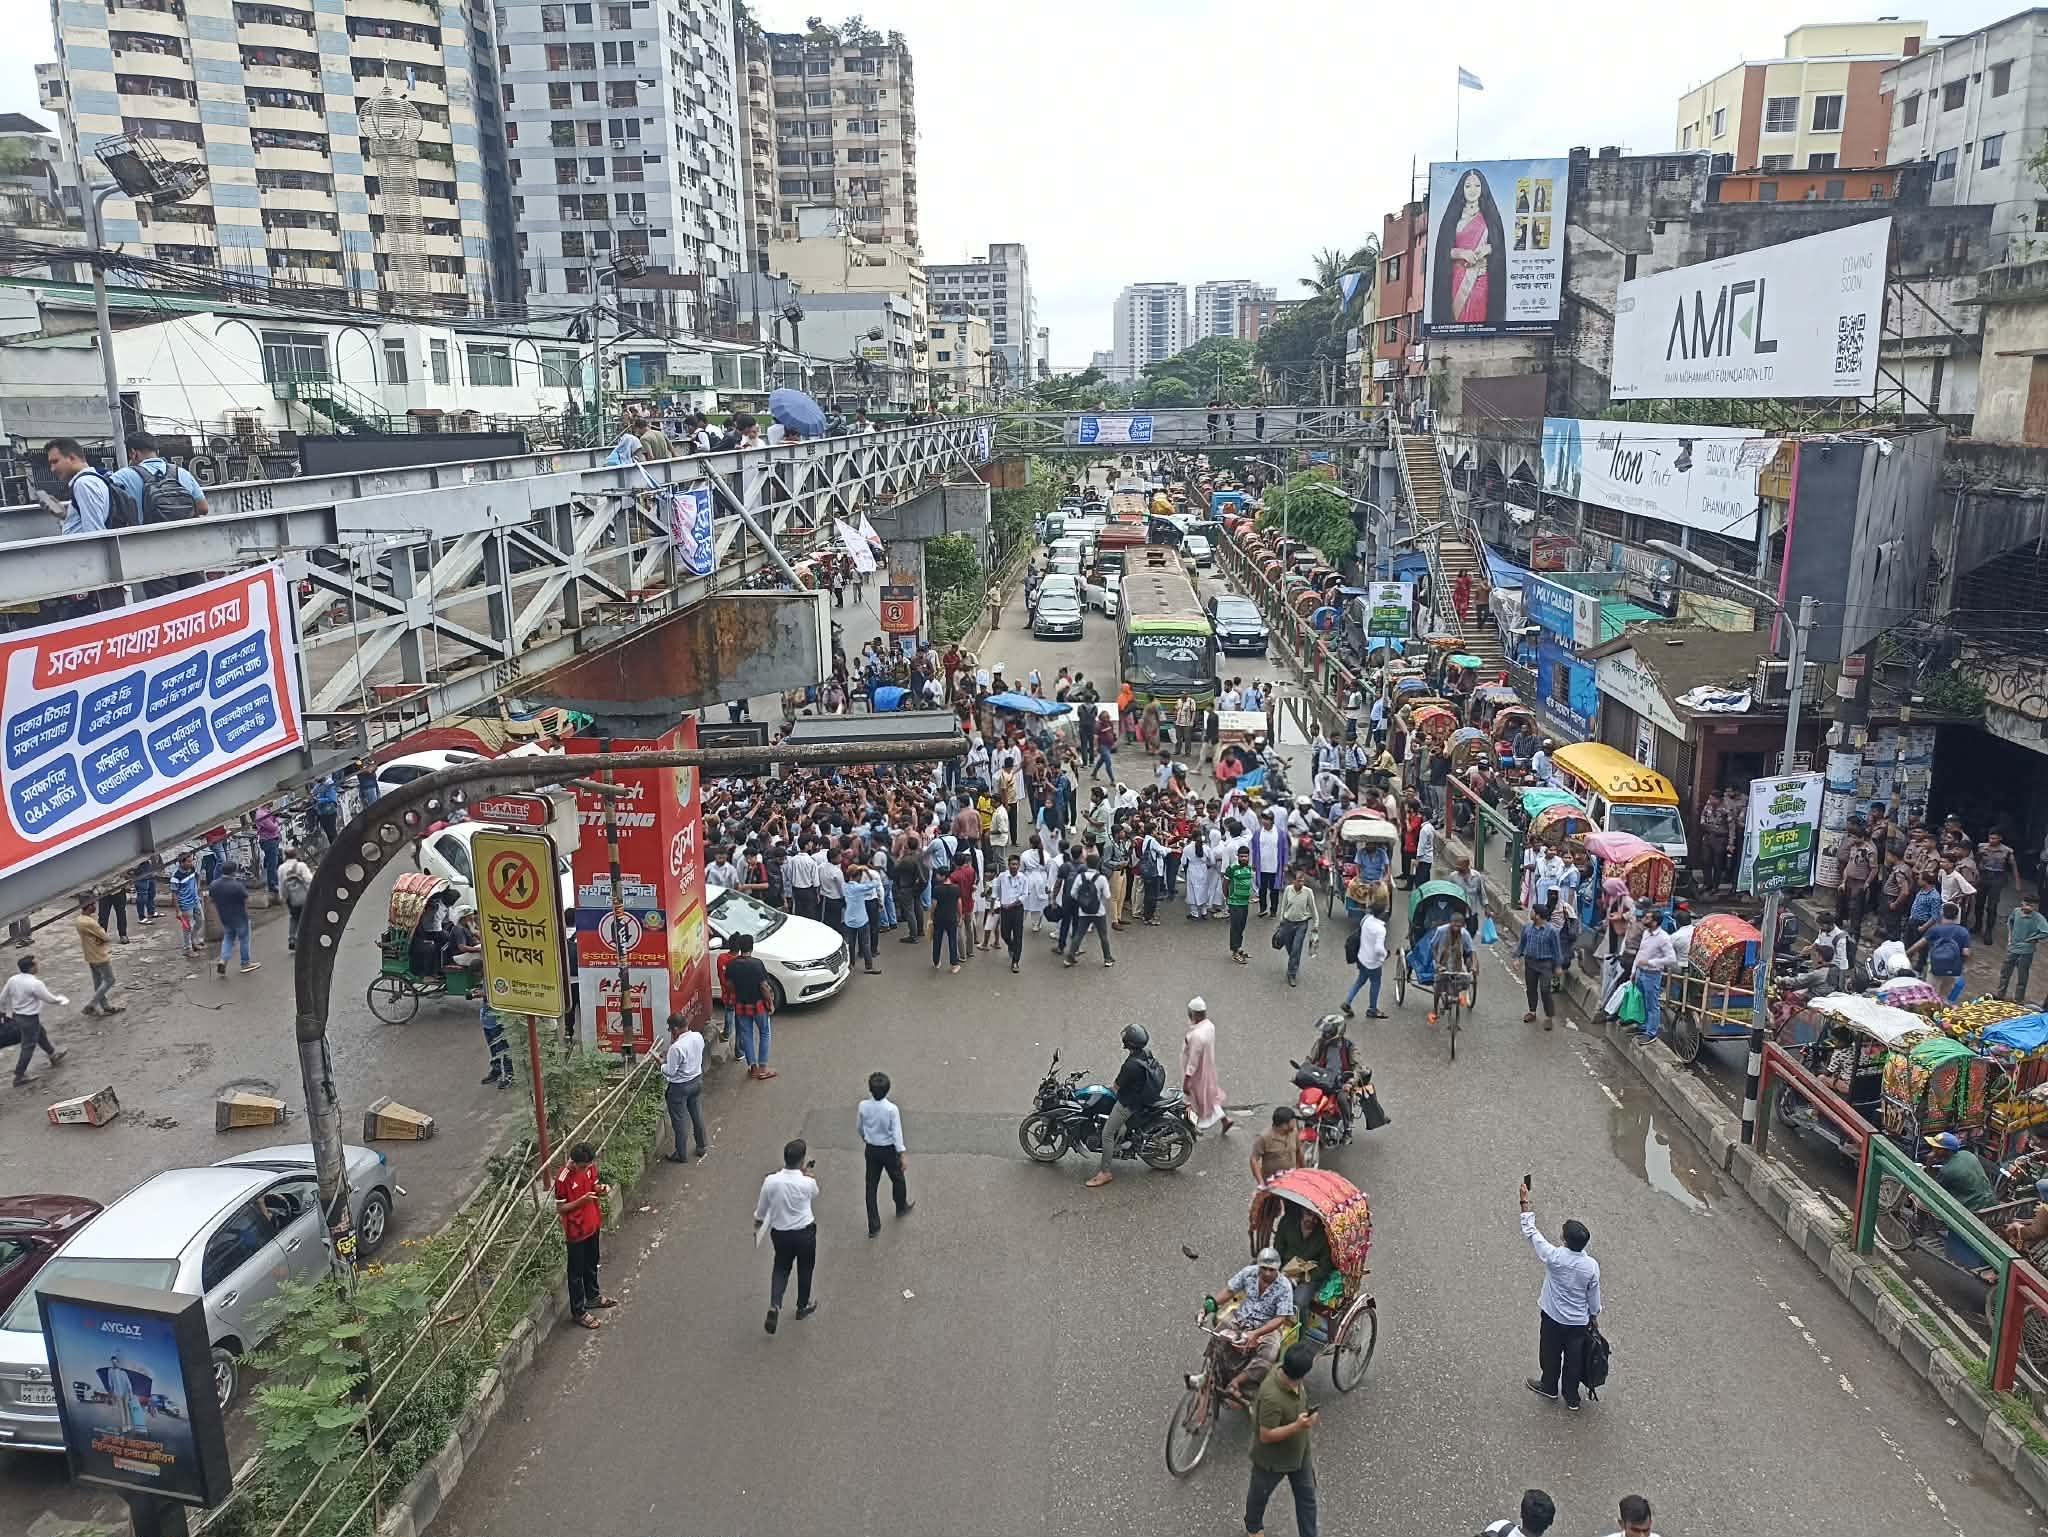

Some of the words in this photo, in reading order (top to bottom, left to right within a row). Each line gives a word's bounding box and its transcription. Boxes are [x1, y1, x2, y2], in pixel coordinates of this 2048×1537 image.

[1716, 367, 1758, 383] FOUNDATION
[1760, 366, 1774, 381] LTD
[1609, 431, 1644, 484] Icon
[1702, 496, 1743, 520] DHANMONDI
[48, 639, 103, 677] সকল
[106, 624, 160, 660] শাখায়
[163, 610, 206, 645] সমান
[209, 598, 241, 630] সেবা
[161, 673, 185, 692] সকল
[185, 663, 198, 679] বই
[215, 667, 245, 688] আলাদা
[94, 691, 118, 713] একই
[118, 685, 132, 704] ফি
[14, 713, 42, 738] ঢাকার
[43, 702, 72, 728] টিচার
[89, 711, 113, 733] একই
[112, 702, 133, 722] সেবা
[172, 718, 202, 743] পরিবর্তন
[13, 737, 39, 758] সকল
[39, 721, 68, 746] শাখায়
[95, 745, 130, 773] সম্মিলিত
[20, 766, 67, 804] সার্বক্ষণিক
[97, 759, 144, 796] মেধাতালিকা
[24, 804, 50, 825] Q&A
[49, 786, 77, 811] সার্ভিস
[597, 829, 633, 838] CEENT
[488, 913, 547, 943] ইউটার্ন
[496, 939, 544, 967] নিষেধ
[101, 1320, 143, 1336] AYGAZ
